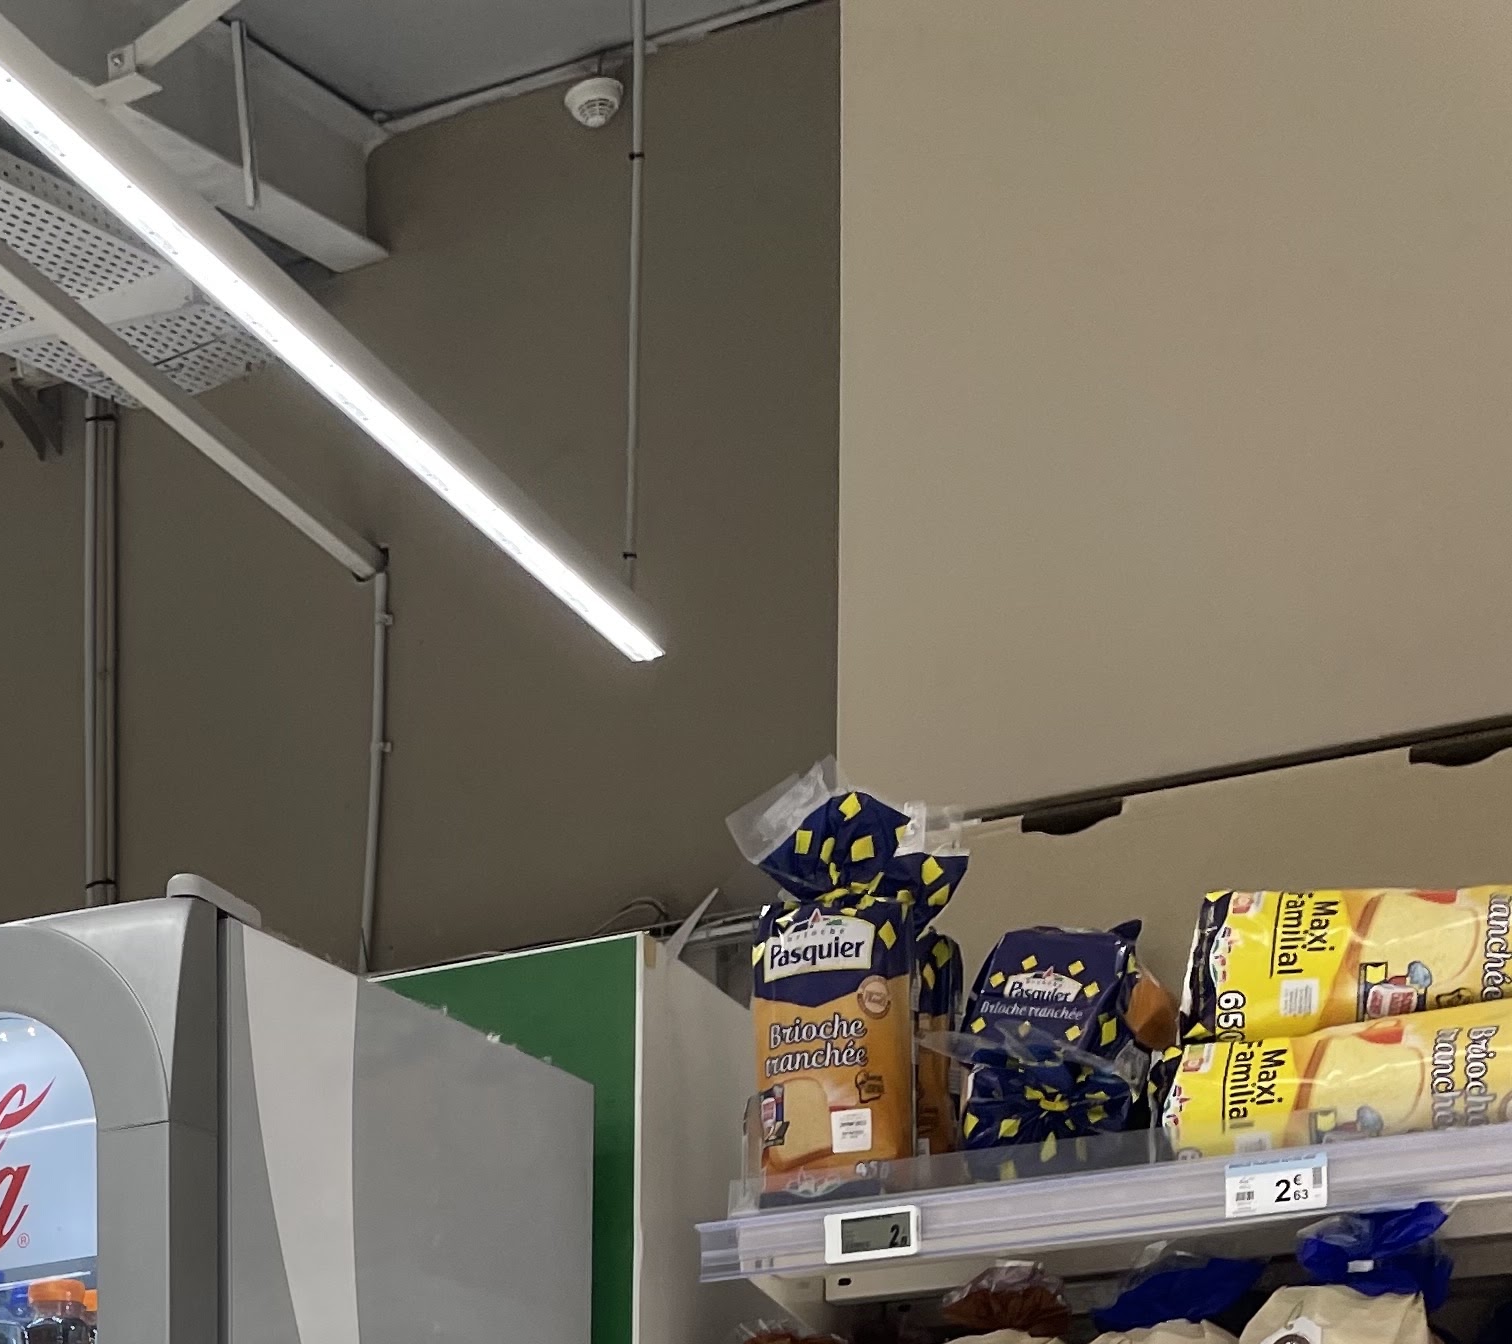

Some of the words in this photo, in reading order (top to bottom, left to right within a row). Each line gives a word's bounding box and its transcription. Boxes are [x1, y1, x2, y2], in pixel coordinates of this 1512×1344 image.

[1306, 899, 1339, 953] Maxi
[769, 940, 865, 971] Pasquier
[769, 1013, 866, 1050] Brioche
[765, 1039, 868, 1078] tranchée
[1256, 1049, 1288, 1106] Maxi
